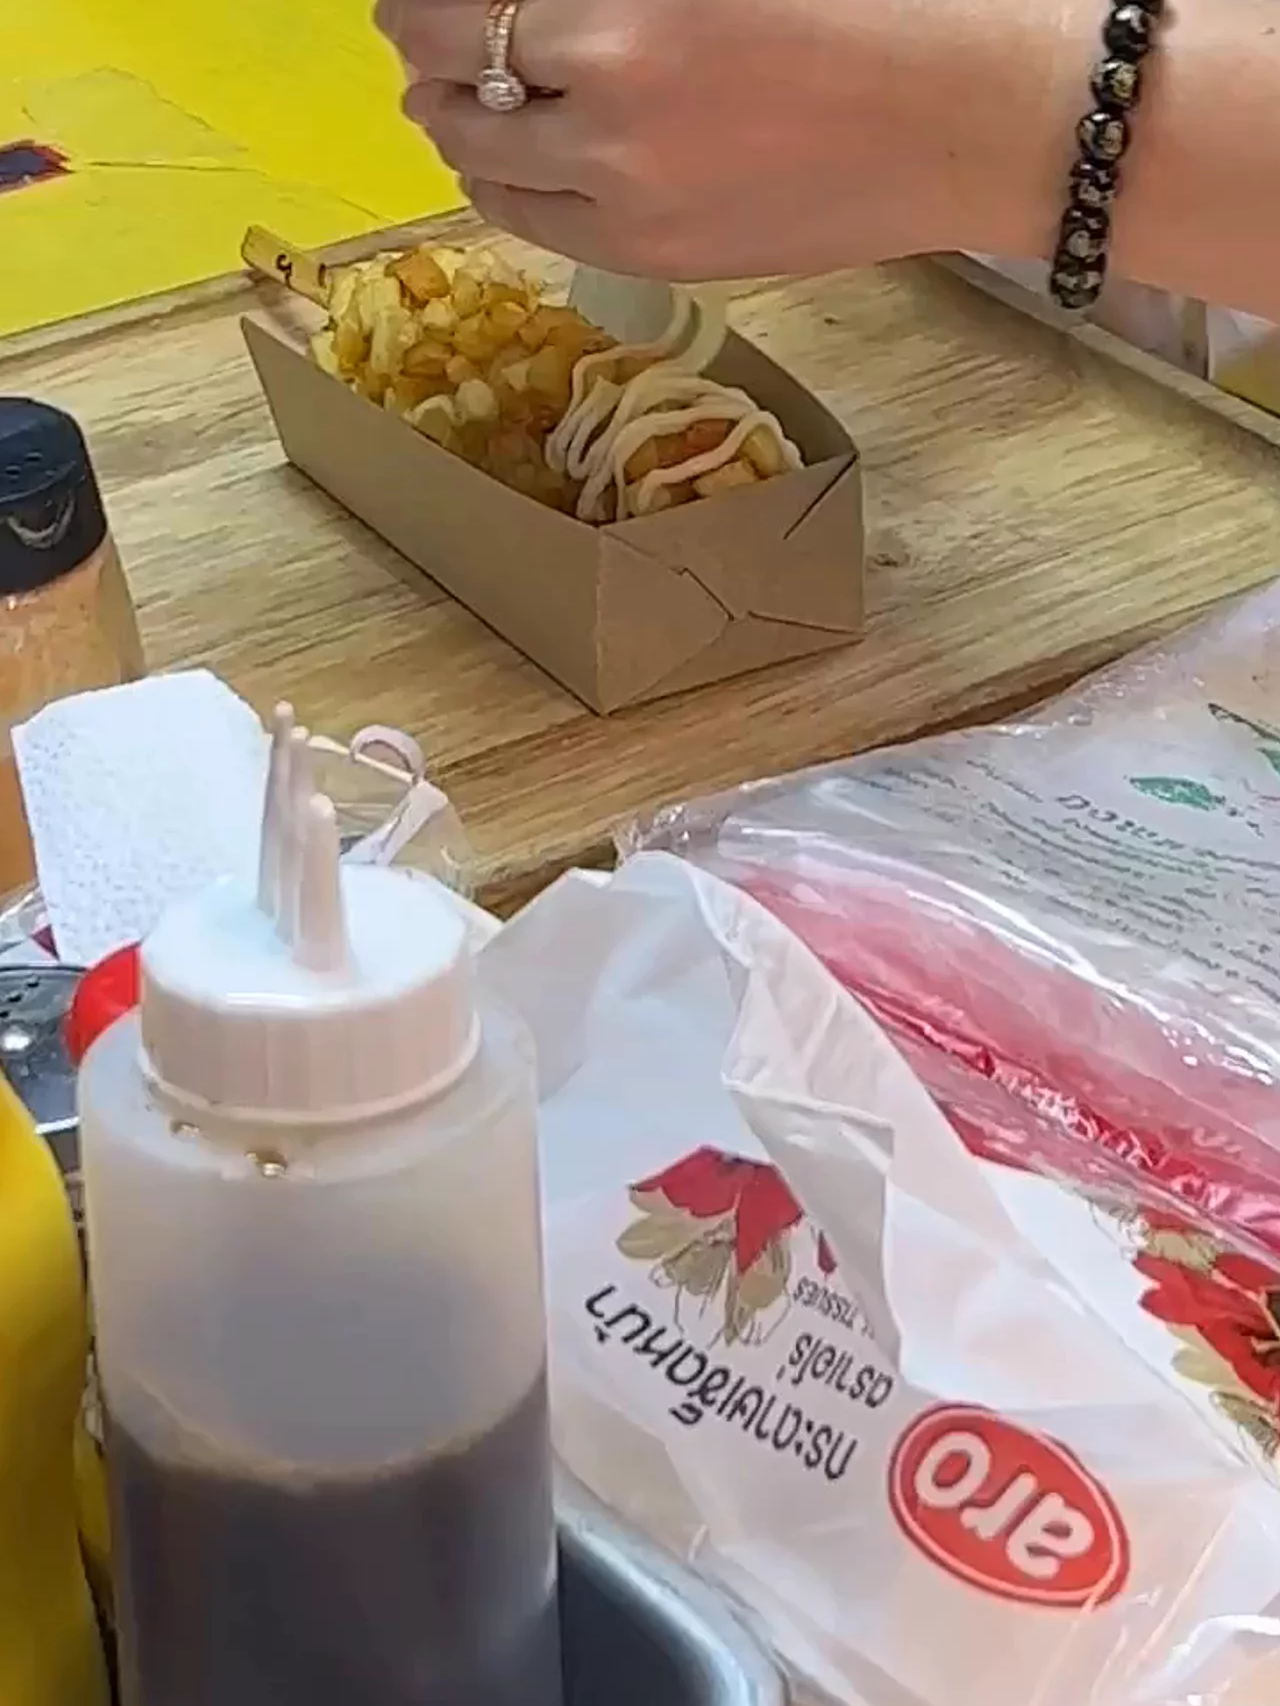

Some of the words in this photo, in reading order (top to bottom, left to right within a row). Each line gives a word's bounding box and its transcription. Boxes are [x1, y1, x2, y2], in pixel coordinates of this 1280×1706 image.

[584, 1283, 858, 1482] กระดาษเช็ดหน้า
[913, 1429, 1096, 1581] aro
